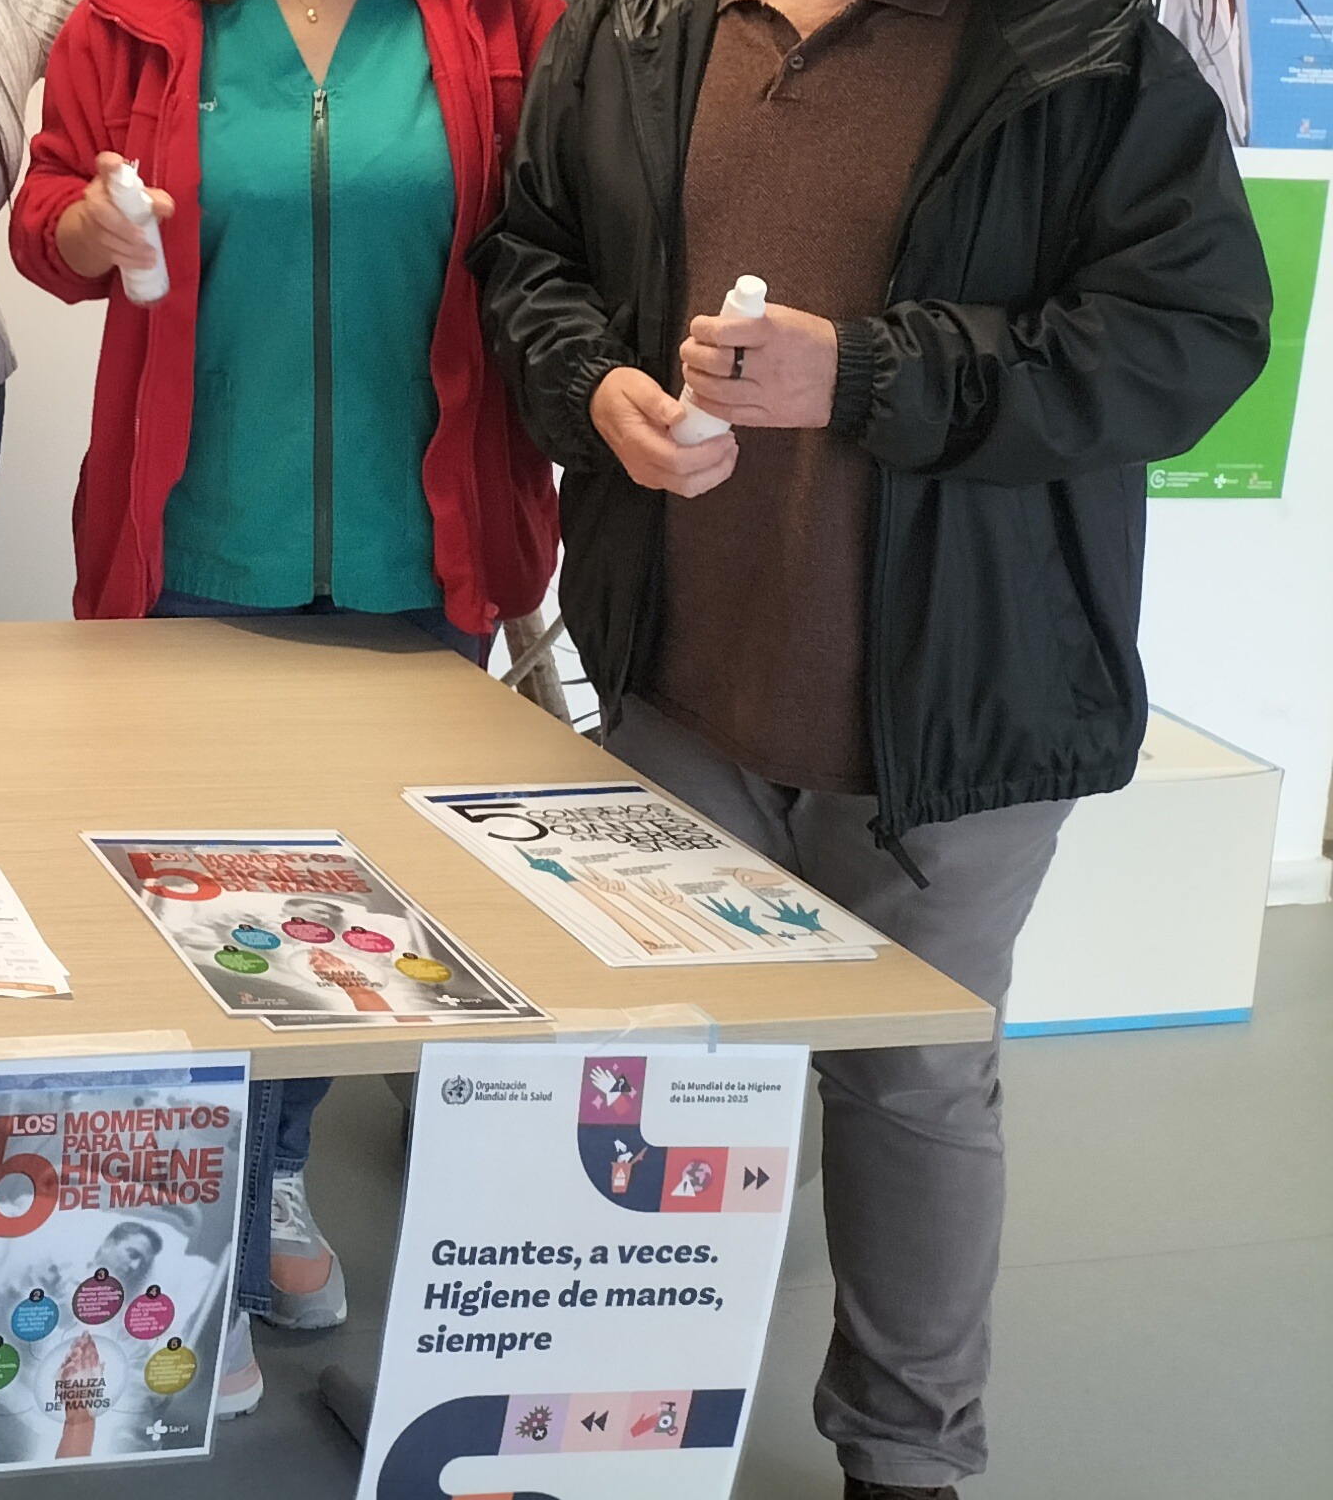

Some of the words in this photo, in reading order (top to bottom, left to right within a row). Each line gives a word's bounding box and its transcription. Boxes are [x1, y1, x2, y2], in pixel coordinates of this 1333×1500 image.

[447, 803, 549, 842] 5
[194, 853, 347, 864] MOMENTOS
[127, 852, 222, 901] 5
[12, 1114, 56, 1135] LOS
[64, 1106, 230, 1136] MOMENTOS
[63, 1133, 122, 1153] PARA
[129, 1132, 157, 1150] LA
[60, 1147, 224, 1186] HIGIENE
[59, 1187, 100, 1211] DE
[109, 1180, 220, 1208] MANOS
[432, 1240, 581, 1270] Guantes,
[590, 1246, 608, 1264] a
[618, 1245, 718, 1263] veces.
[424, 1281, 550, 1316] Higiene
[558, 1280, 597, 1307] de
[605, 1287, 722, 1311] manos,
[417, 1325, 552, 1359] siempre
[55, 1378, 106, 1390] REALIZA
[55, 1388, 104, 1400] HIGIENE
[45, 1402, 61, 1412] DE
[65, 1399, 110, 1410] MANOS
